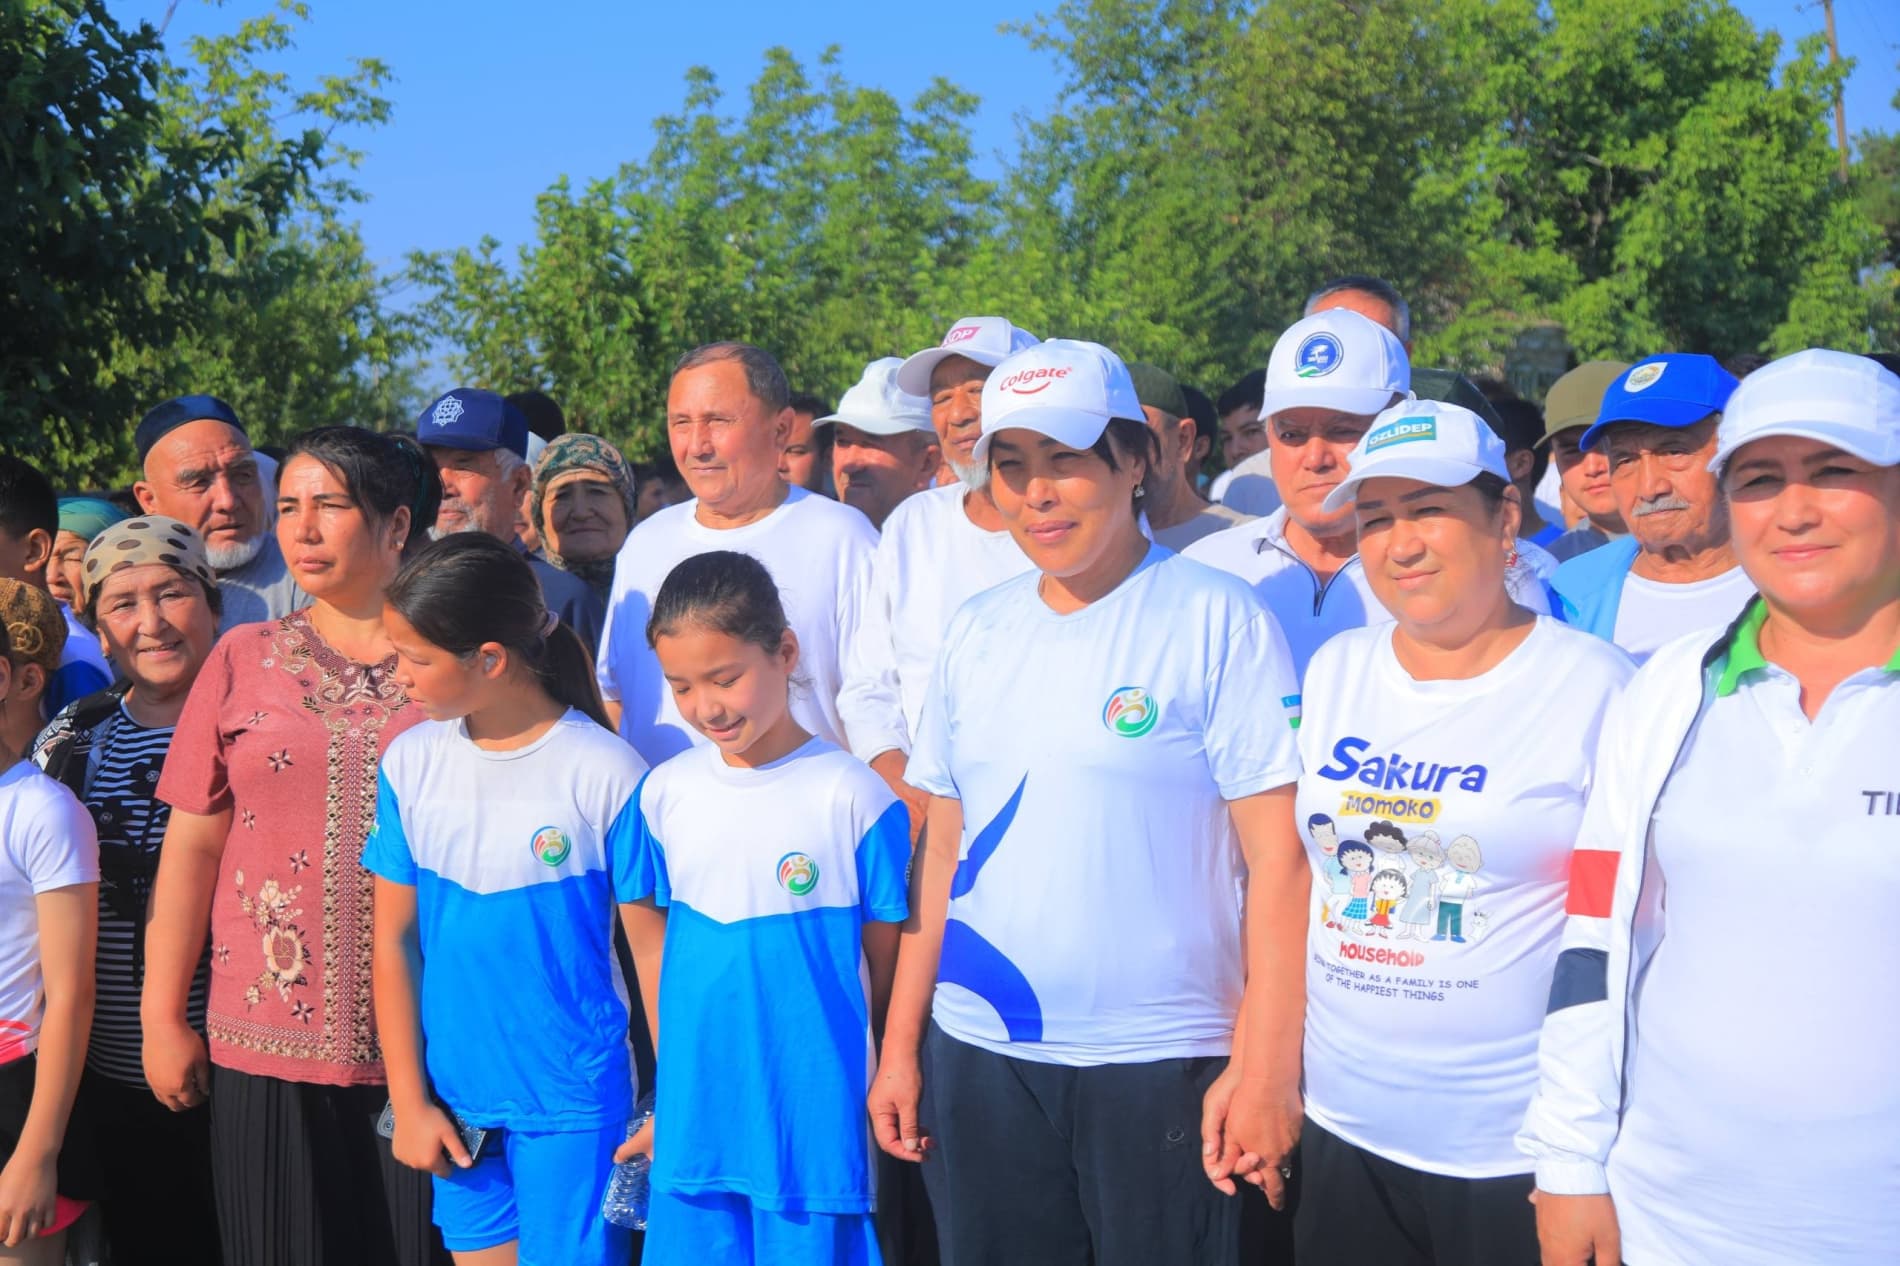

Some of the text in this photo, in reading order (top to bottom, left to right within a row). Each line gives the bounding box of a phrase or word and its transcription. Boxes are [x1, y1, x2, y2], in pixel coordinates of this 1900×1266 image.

[1000, 367, 1068, 391] Colgate
[1317, 736, 1488, 792] Sakura
[1326, 973, 1445, 1002] OF THE HAPPIEST THINGS
[1327, 962, 1365, 979] TOGETHER
[1369, 974, 1381, 982] AS
[1395, 976, 1434, 988] FAMILY
[1439, 980, 1452, 989] IS
[1456, 979, 1480, 989] ONE
